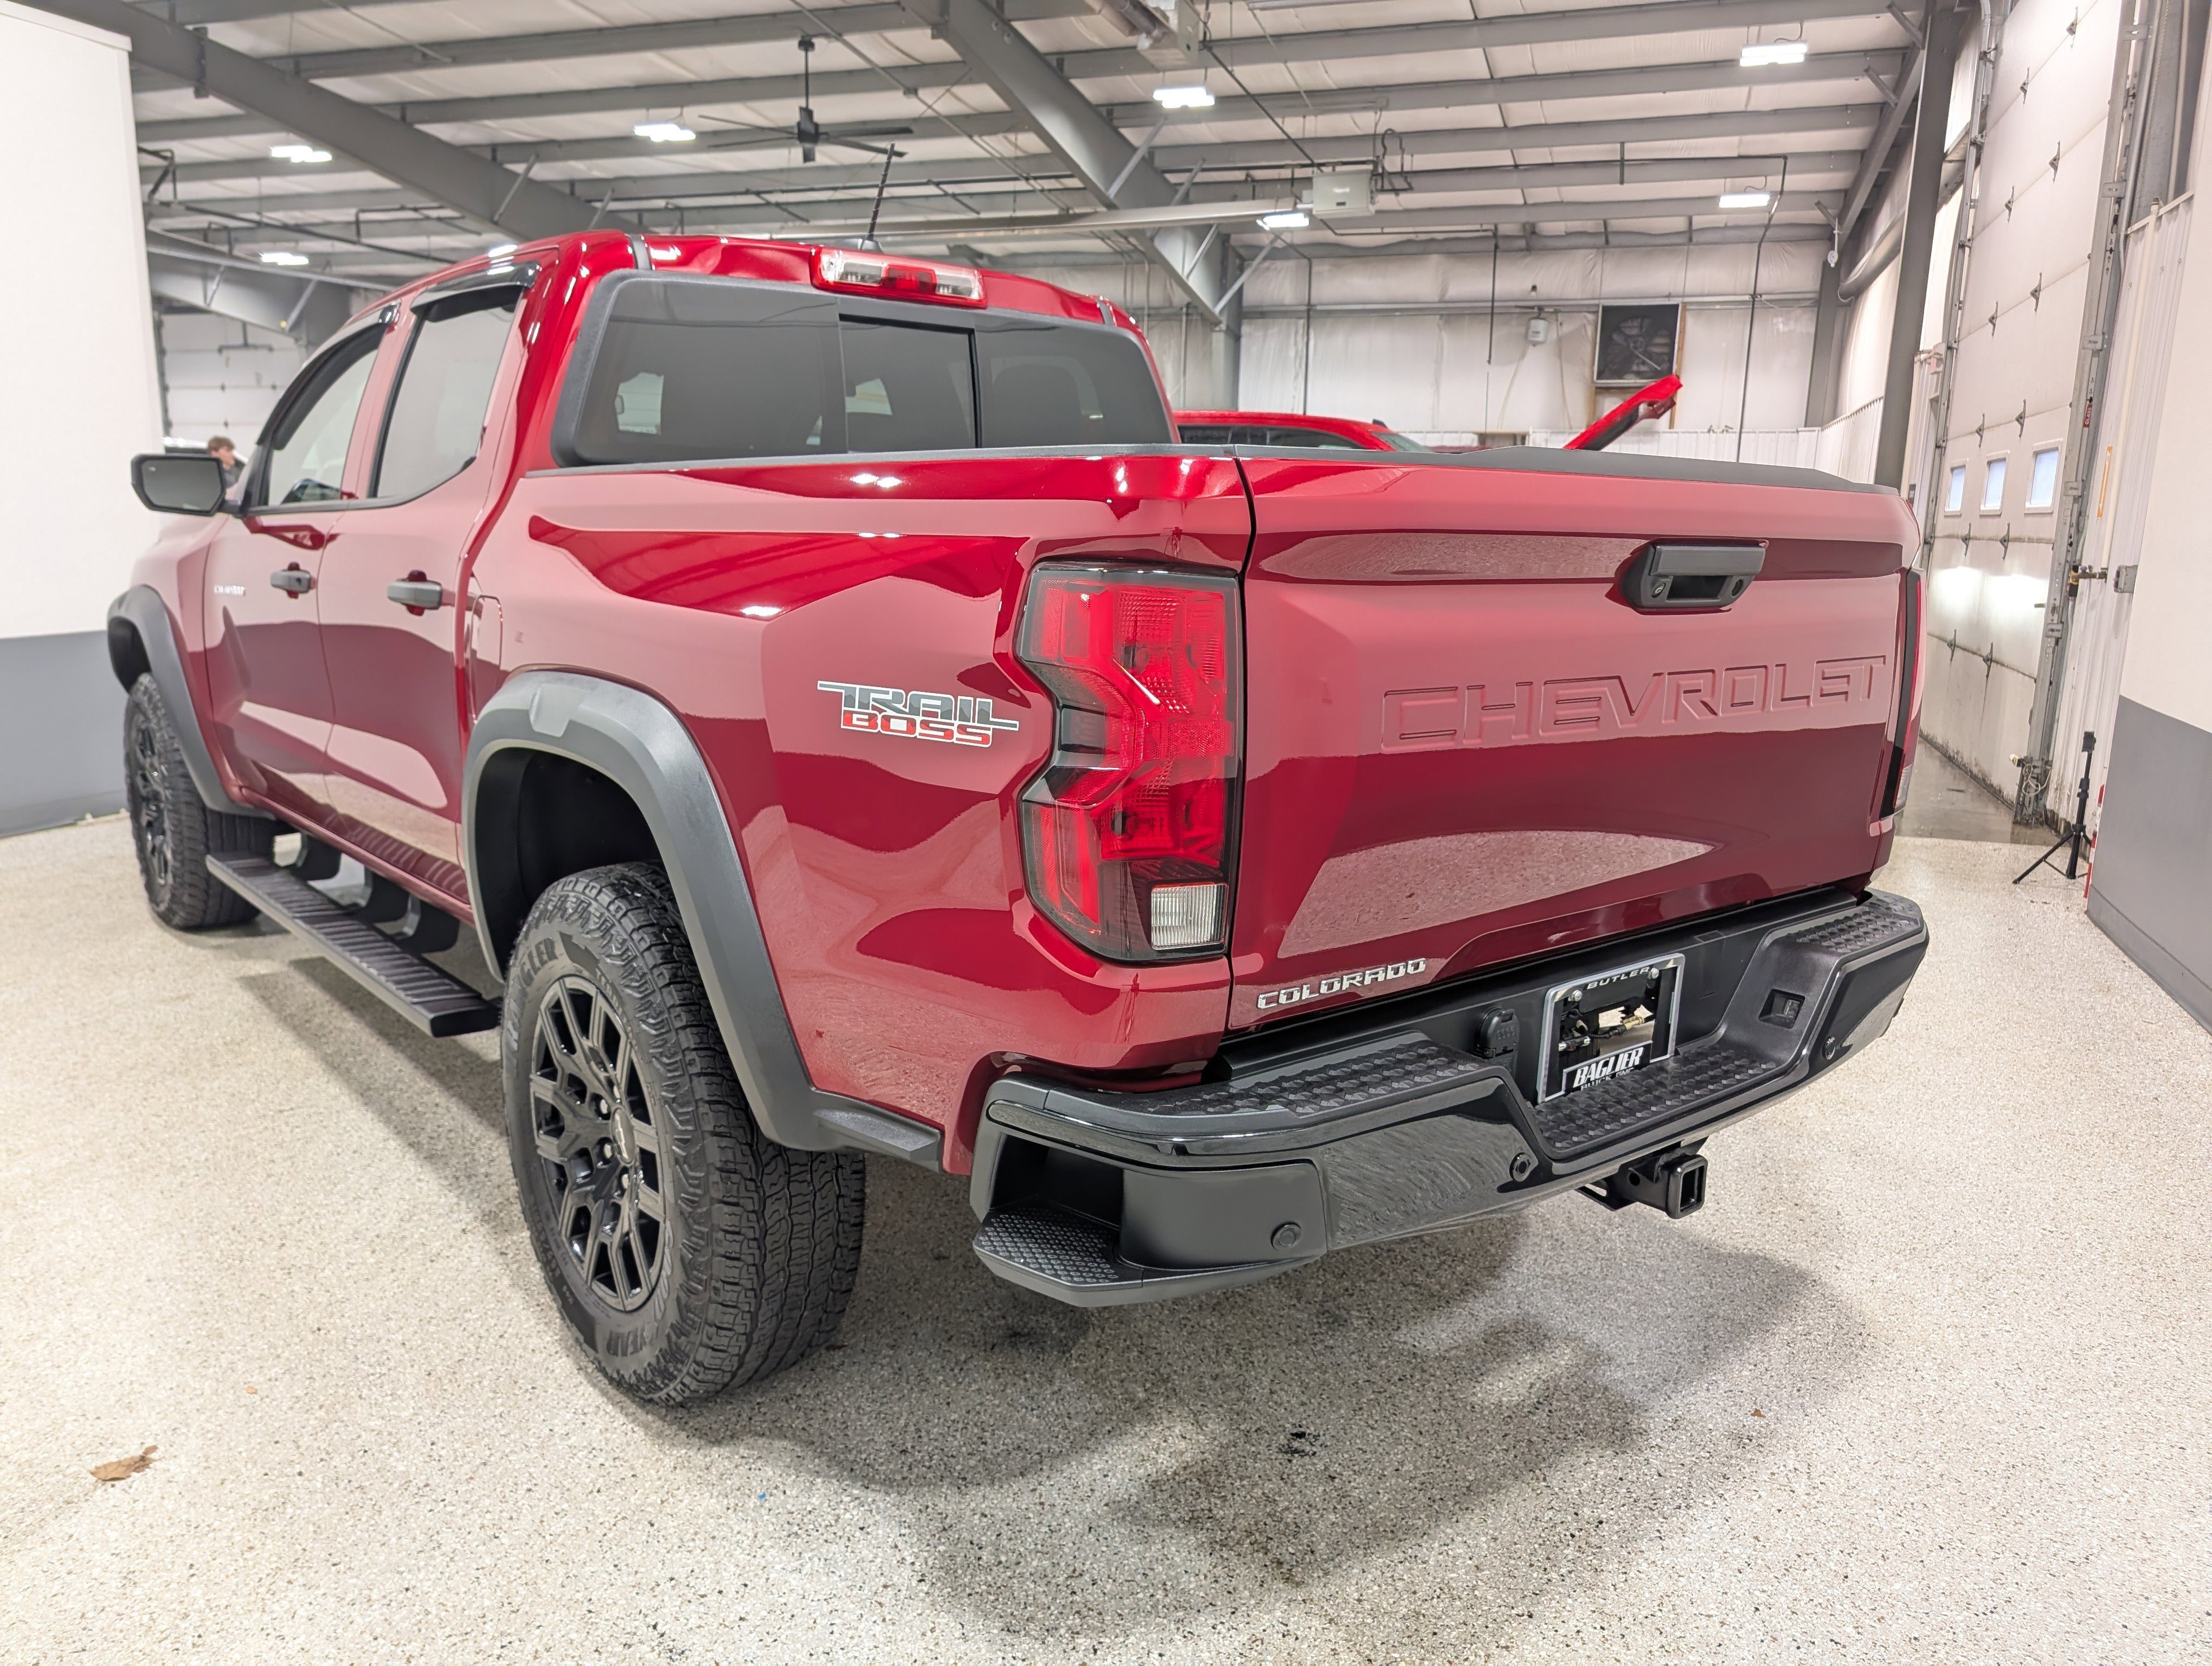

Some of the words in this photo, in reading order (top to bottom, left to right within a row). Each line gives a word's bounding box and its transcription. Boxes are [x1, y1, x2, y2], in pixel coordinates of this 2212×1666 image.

[818, 681, 1019, 731] TRAIL
[1381, 655, 1886, 751] CHEVROLET
[841, 708, 993, 747] BOSS
[1257, 958, 1426, 1009] COLORADO
[1586, 966, 1650, 990] BUTLER
[1573, 1047, 1644, 1088] BAGLIER
